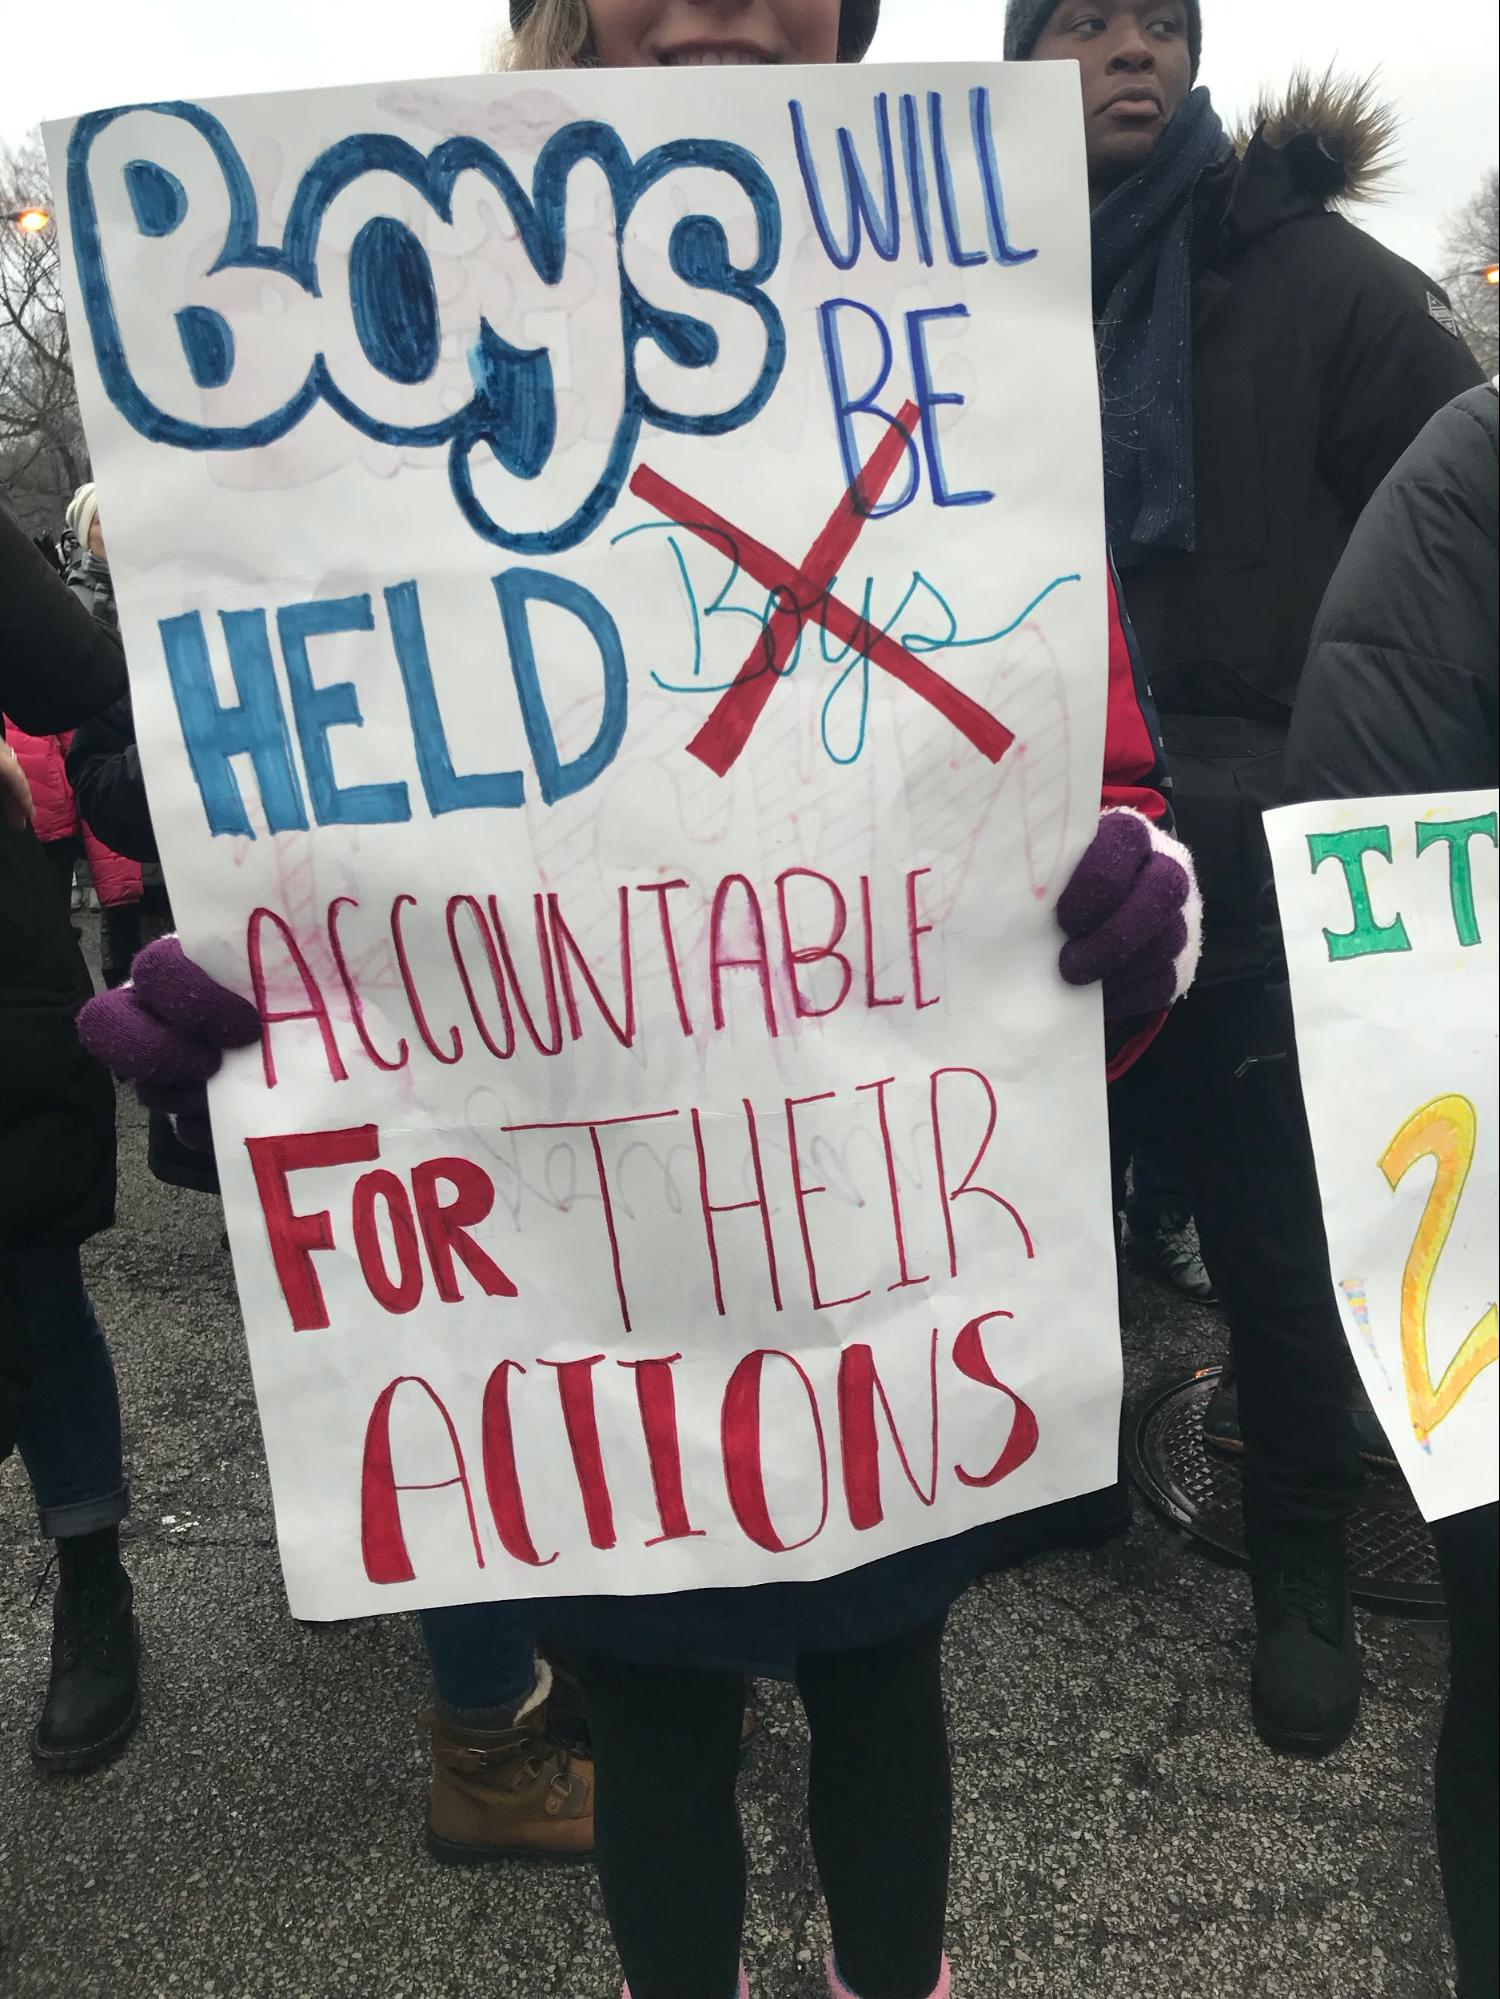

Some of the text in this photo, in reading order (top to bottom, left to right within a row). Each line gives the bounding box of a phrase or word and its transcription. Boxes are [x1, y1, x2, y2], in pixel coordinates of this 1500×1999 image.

[788, 86, 1039, 271] WILL
[66, 99, 787, 555] Boys
[817, 297, 996, 521] BE
[157, 566, 630, 841] HELD
[609, 519, 1082, 767] Boys
[245, 866, 942, 1090] ACCOUNTABLE
[1304, 811, 1499, 962] IT
[243, 1123, 520, 1332] FOR
[500, 1066, 1036, 1332] THEIR
[360, 1310, 1040, 1585] ACTIONS
